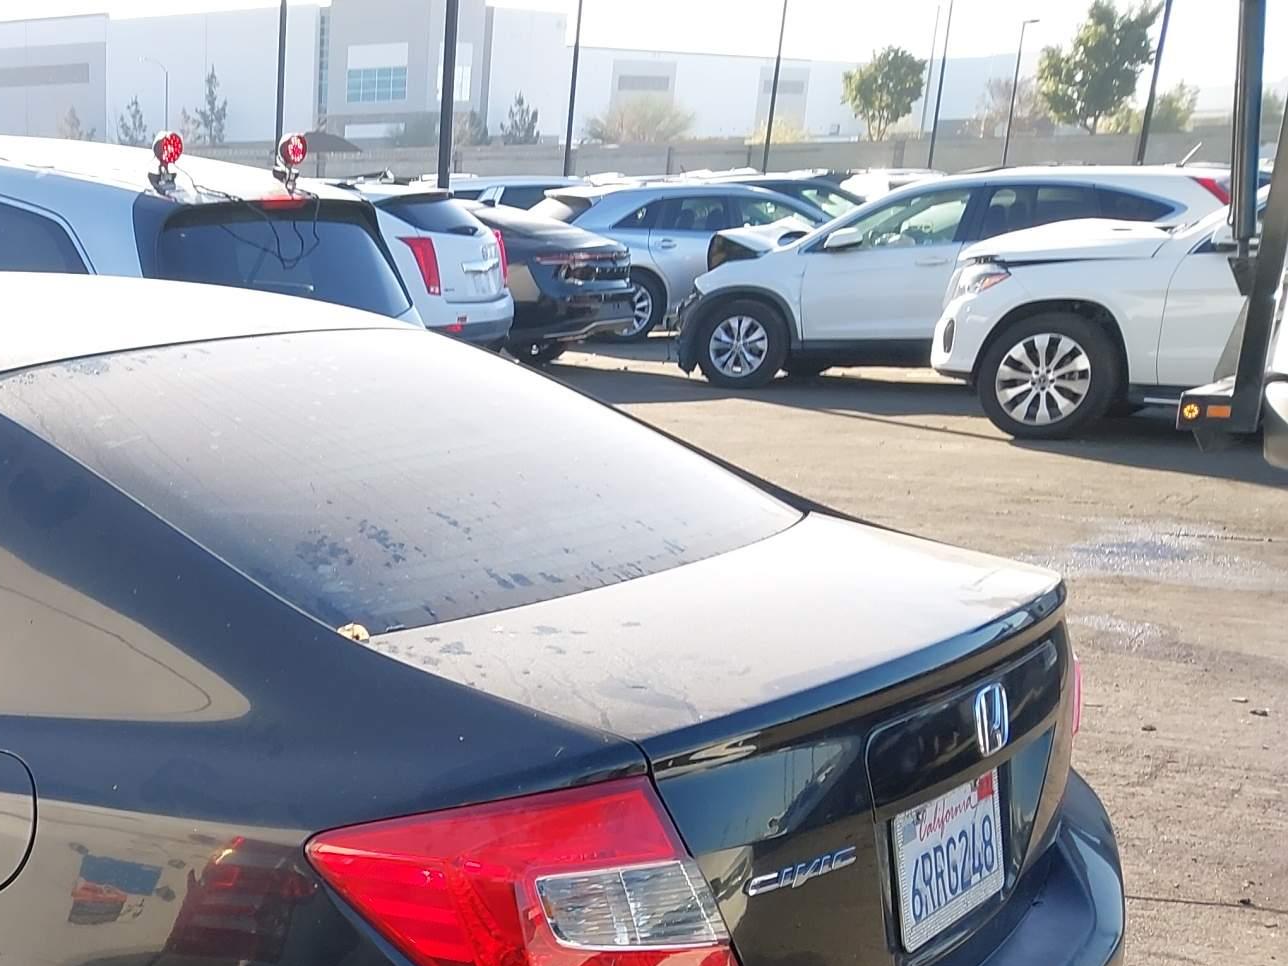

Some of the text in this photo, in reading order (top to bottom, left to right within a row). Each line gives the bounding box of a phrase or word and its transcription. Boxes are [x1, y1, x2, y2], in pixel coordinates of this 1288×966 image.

[919, 795, 977, 842] California
[748, 846, 857, 897] CIVIC
[912, 815, 995, 923] 6RRG248
